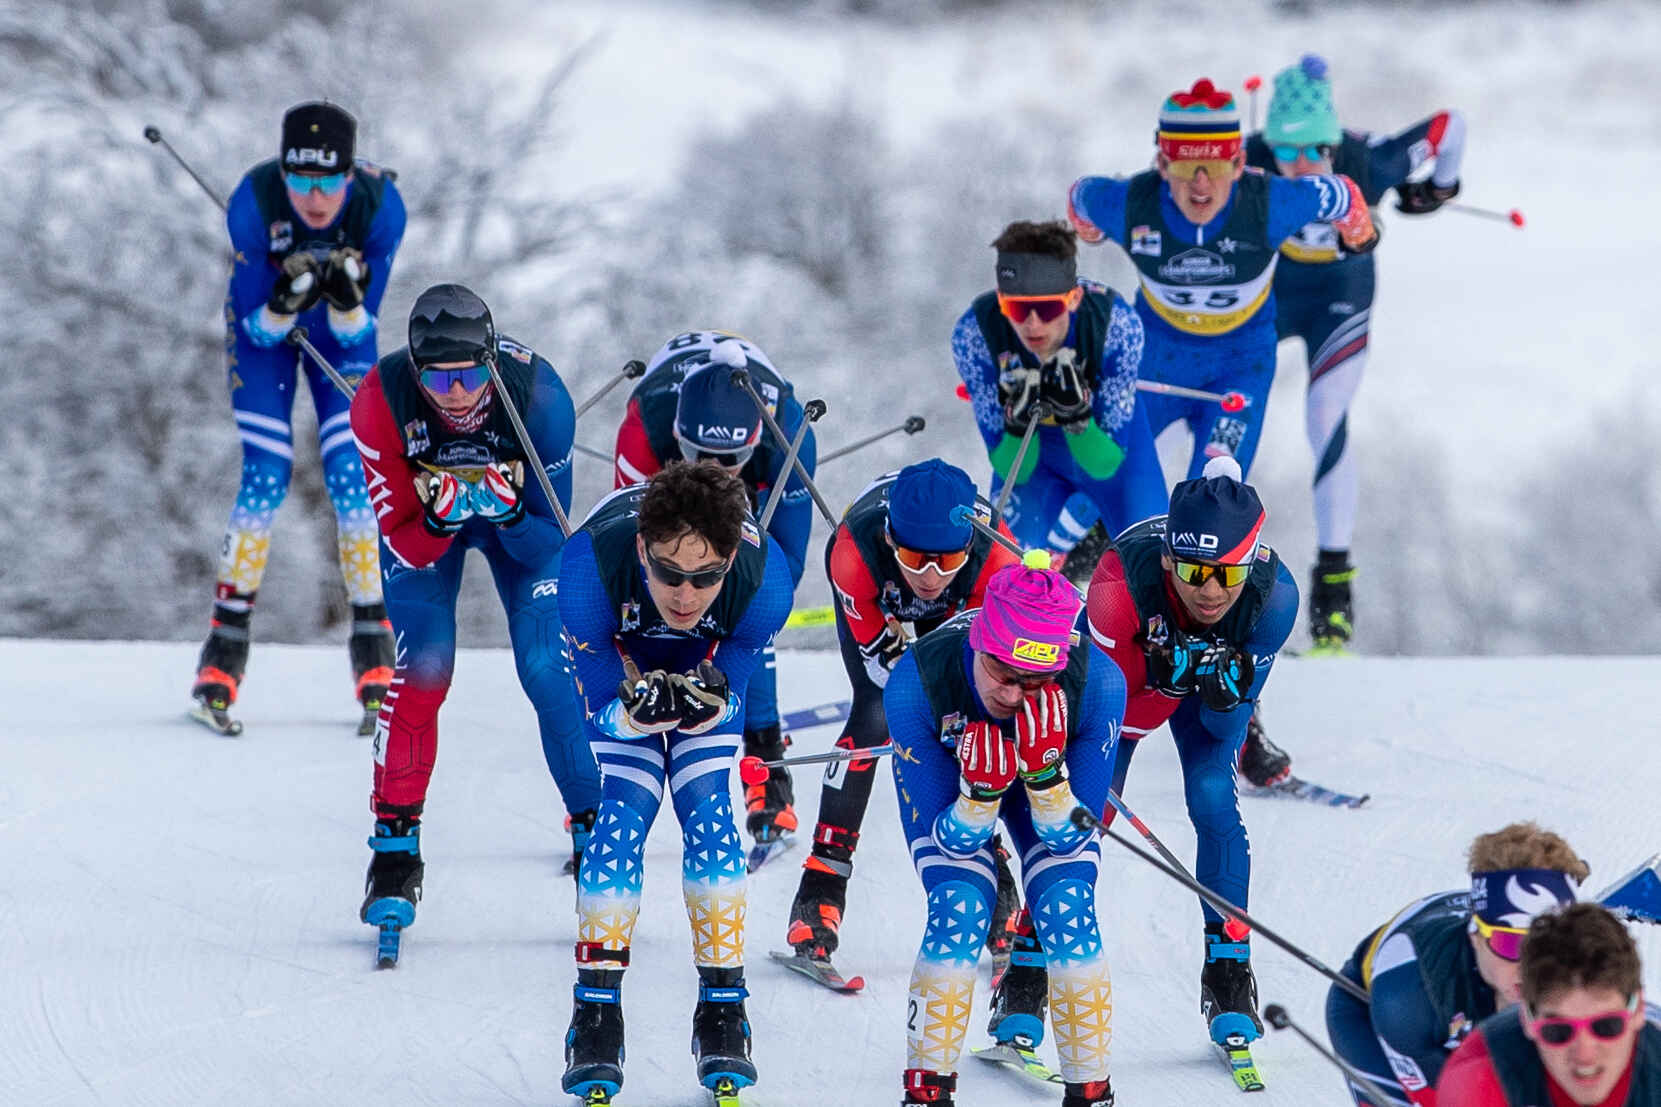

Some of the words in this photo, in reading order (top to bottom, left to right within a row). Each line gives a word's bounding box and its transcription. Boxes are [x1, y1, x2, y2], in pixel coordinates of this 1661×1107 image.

[285, 147, 338, 167] APU
[1161, 288, 1240, 308] 35
[907, 999, 918, 1031] 2
